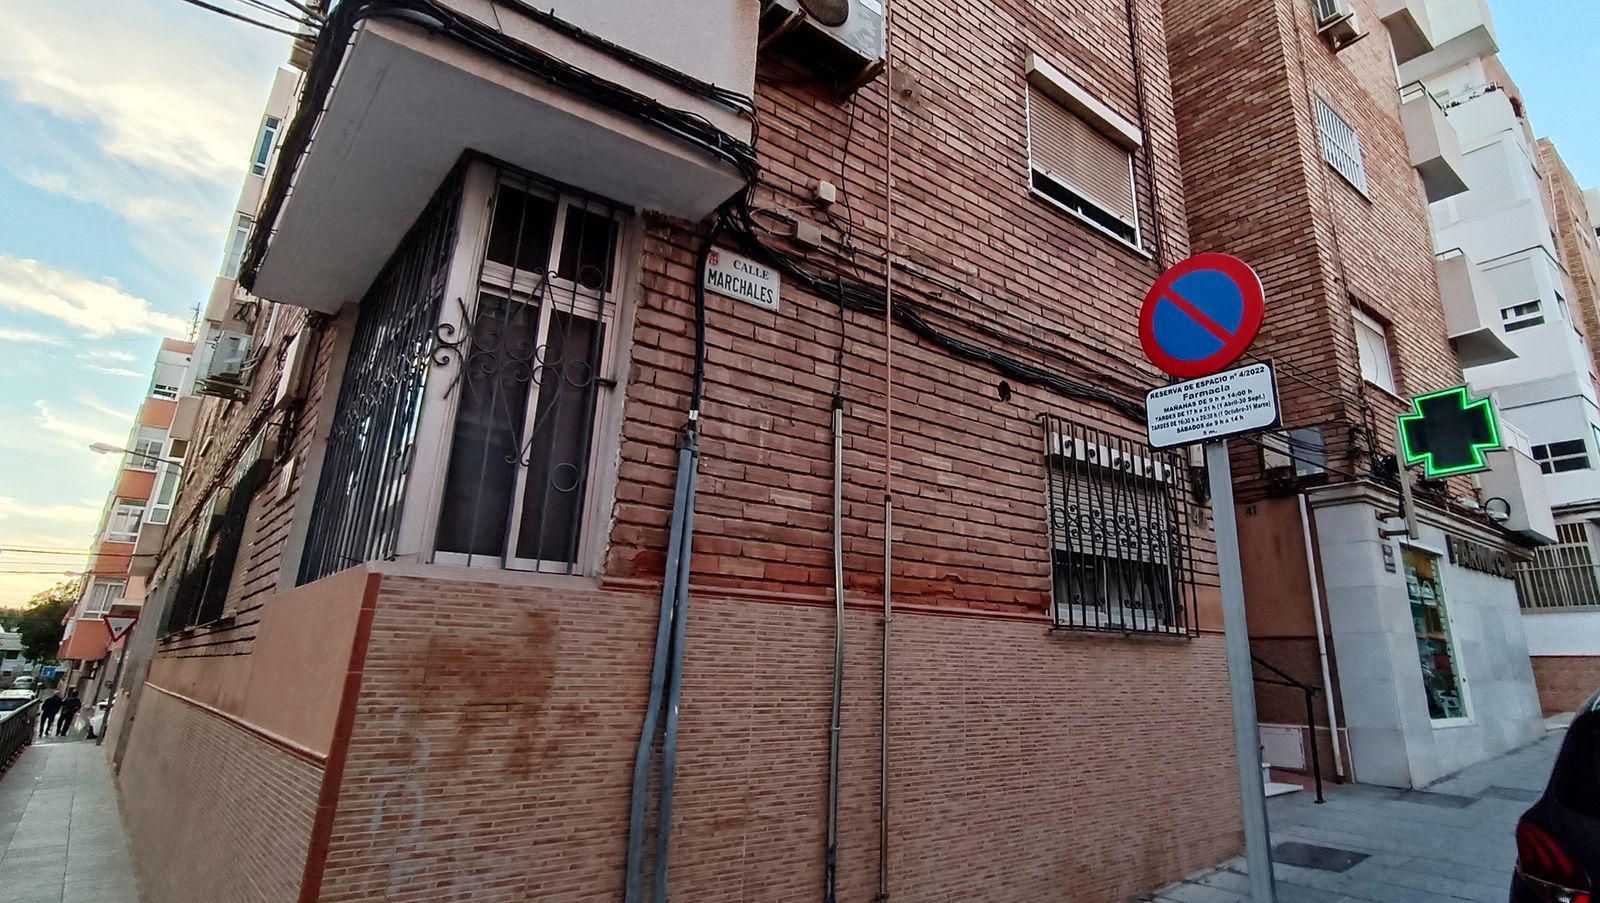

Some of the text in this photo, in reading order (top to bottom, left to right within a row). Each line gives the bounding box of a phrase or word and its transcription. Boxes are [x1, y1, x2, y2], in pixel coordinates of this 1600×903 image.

[733, 260, 769, 280] CALLE
[708, 268, 773, 304] MARCHALES
[1150, 387, 1182, 399] RESERVA
[1196, 376, 1228, 388] ESPACIO
[1239, 367, 1264, 377] 4/2022
[1183, 385, 1230, 401] Farmacia
[1164, 402, 1196, 413] MAÑANAS
[1155, 414, 1176, 422] TARDES
[1151, 422, 1170, 431] TARDES
[1246, 505, 1256, 516] 41
